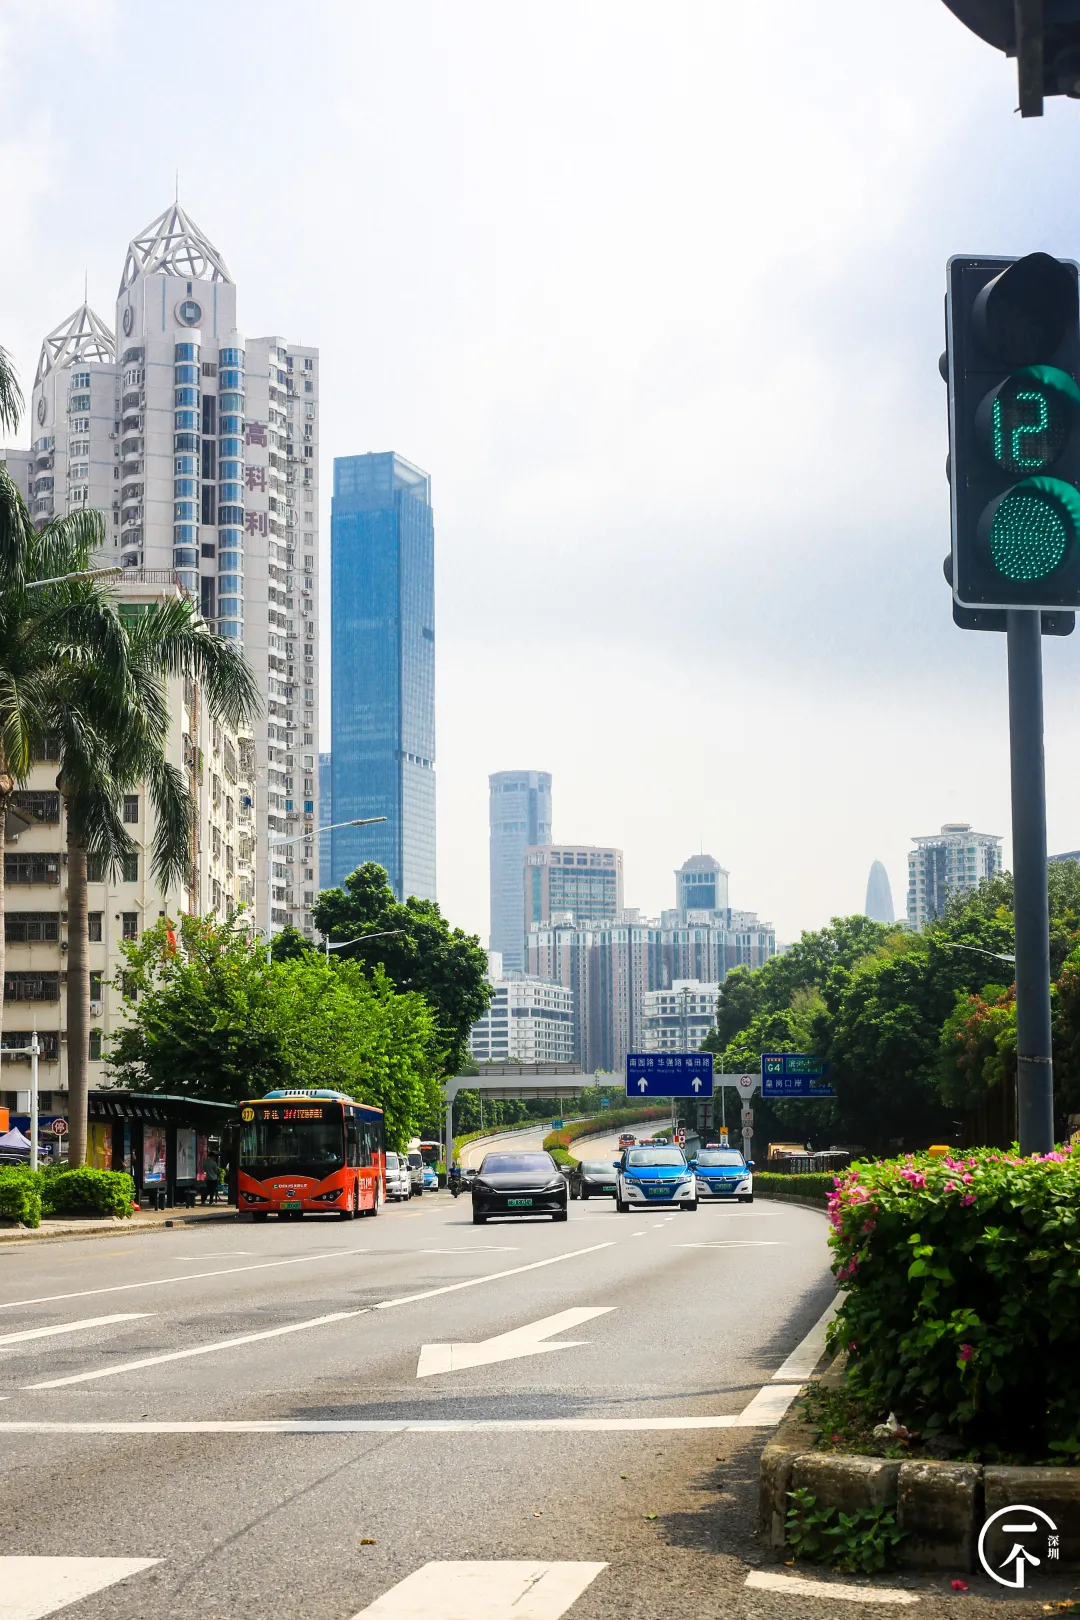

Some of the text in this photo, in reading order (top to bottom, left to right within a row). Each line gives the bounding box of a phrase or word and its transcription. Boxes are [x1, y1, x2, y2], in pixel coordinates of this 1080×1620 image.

[993, 392, 1048, 467] 12
[245, 421, 268, 538] 高科利
[629, 1058, 710, 1067] 南园路 华强路 福田路
[767, 1064, 781, 1072] G4
[765, 1079, 802, 1088] 皇岗口岸
[243, 1110, 254, 1120] 377
[55, 1122, 65, 1133] 停
